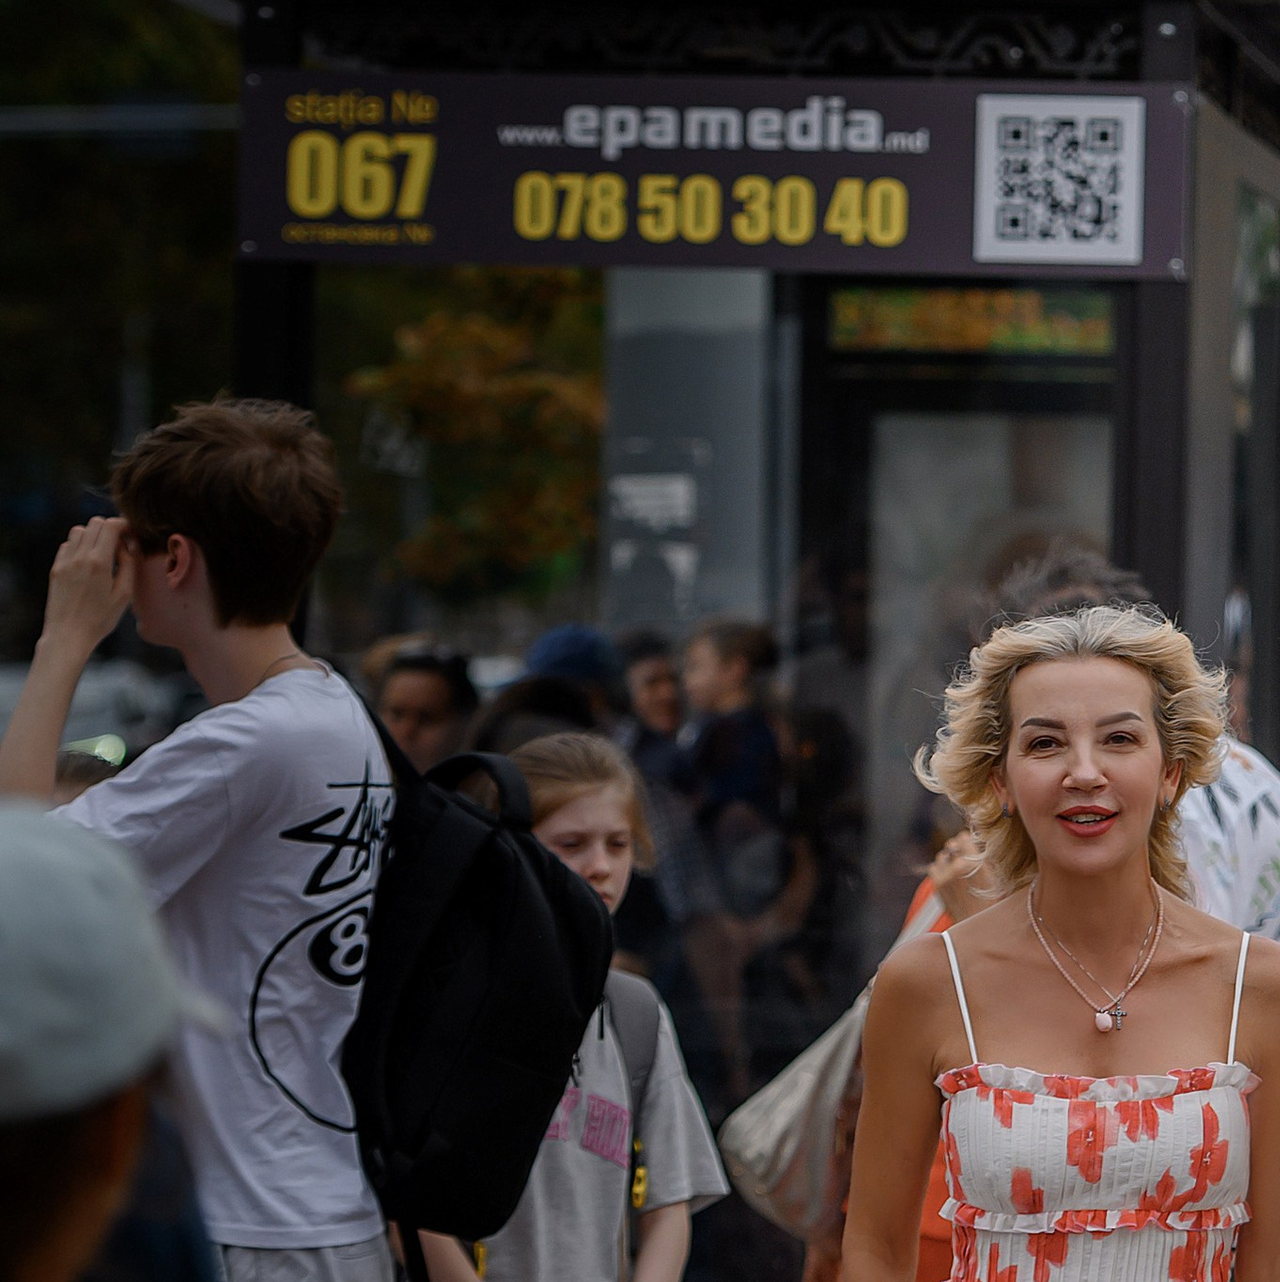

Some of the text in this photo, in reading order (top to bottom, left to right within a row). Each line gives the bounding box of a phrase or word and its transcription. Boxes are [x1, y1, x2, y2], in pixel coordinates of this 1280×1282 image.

[497, 95, 931, 162] www.epamedia.md
[286, 129, 438, 220] 067
[513, 170, 910, 247] 078 50 30 40
